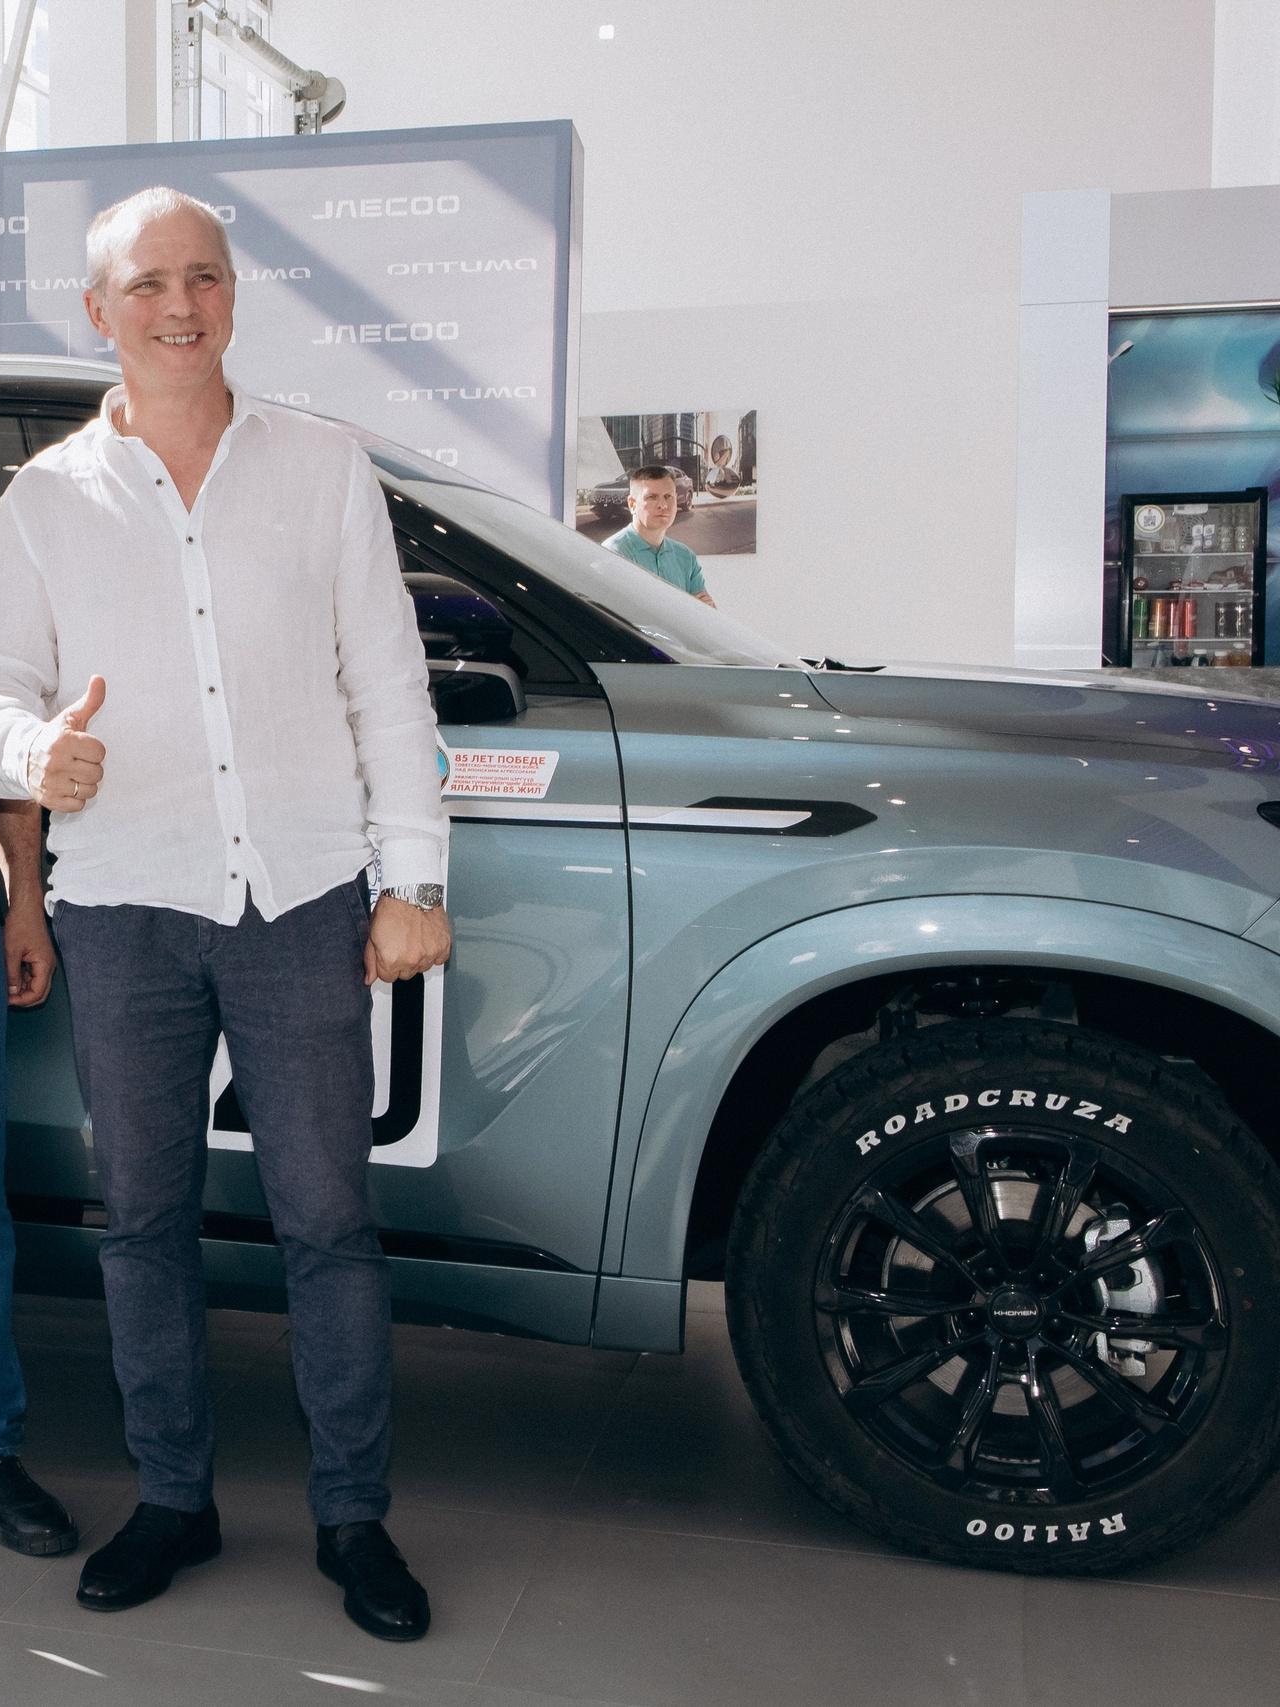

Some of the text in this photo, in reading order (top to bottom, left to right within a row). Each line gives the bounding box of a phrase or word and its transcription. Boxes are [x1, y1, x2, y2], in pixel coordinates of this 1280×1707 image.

[312, 193, 461, 221] JAECOO
[311, 321, 460, 346] JAECOO
[454, 754, 546, 766] 85 ЛЕТ ПОБЕДЕ
[450, 784, 542, 795] ЯЛАЛТЫН 85 ЖИЛ
[854, 1089, 1133, 1155] ROADCRUZA
[965, 1513, 1127, 1543] RA1100
